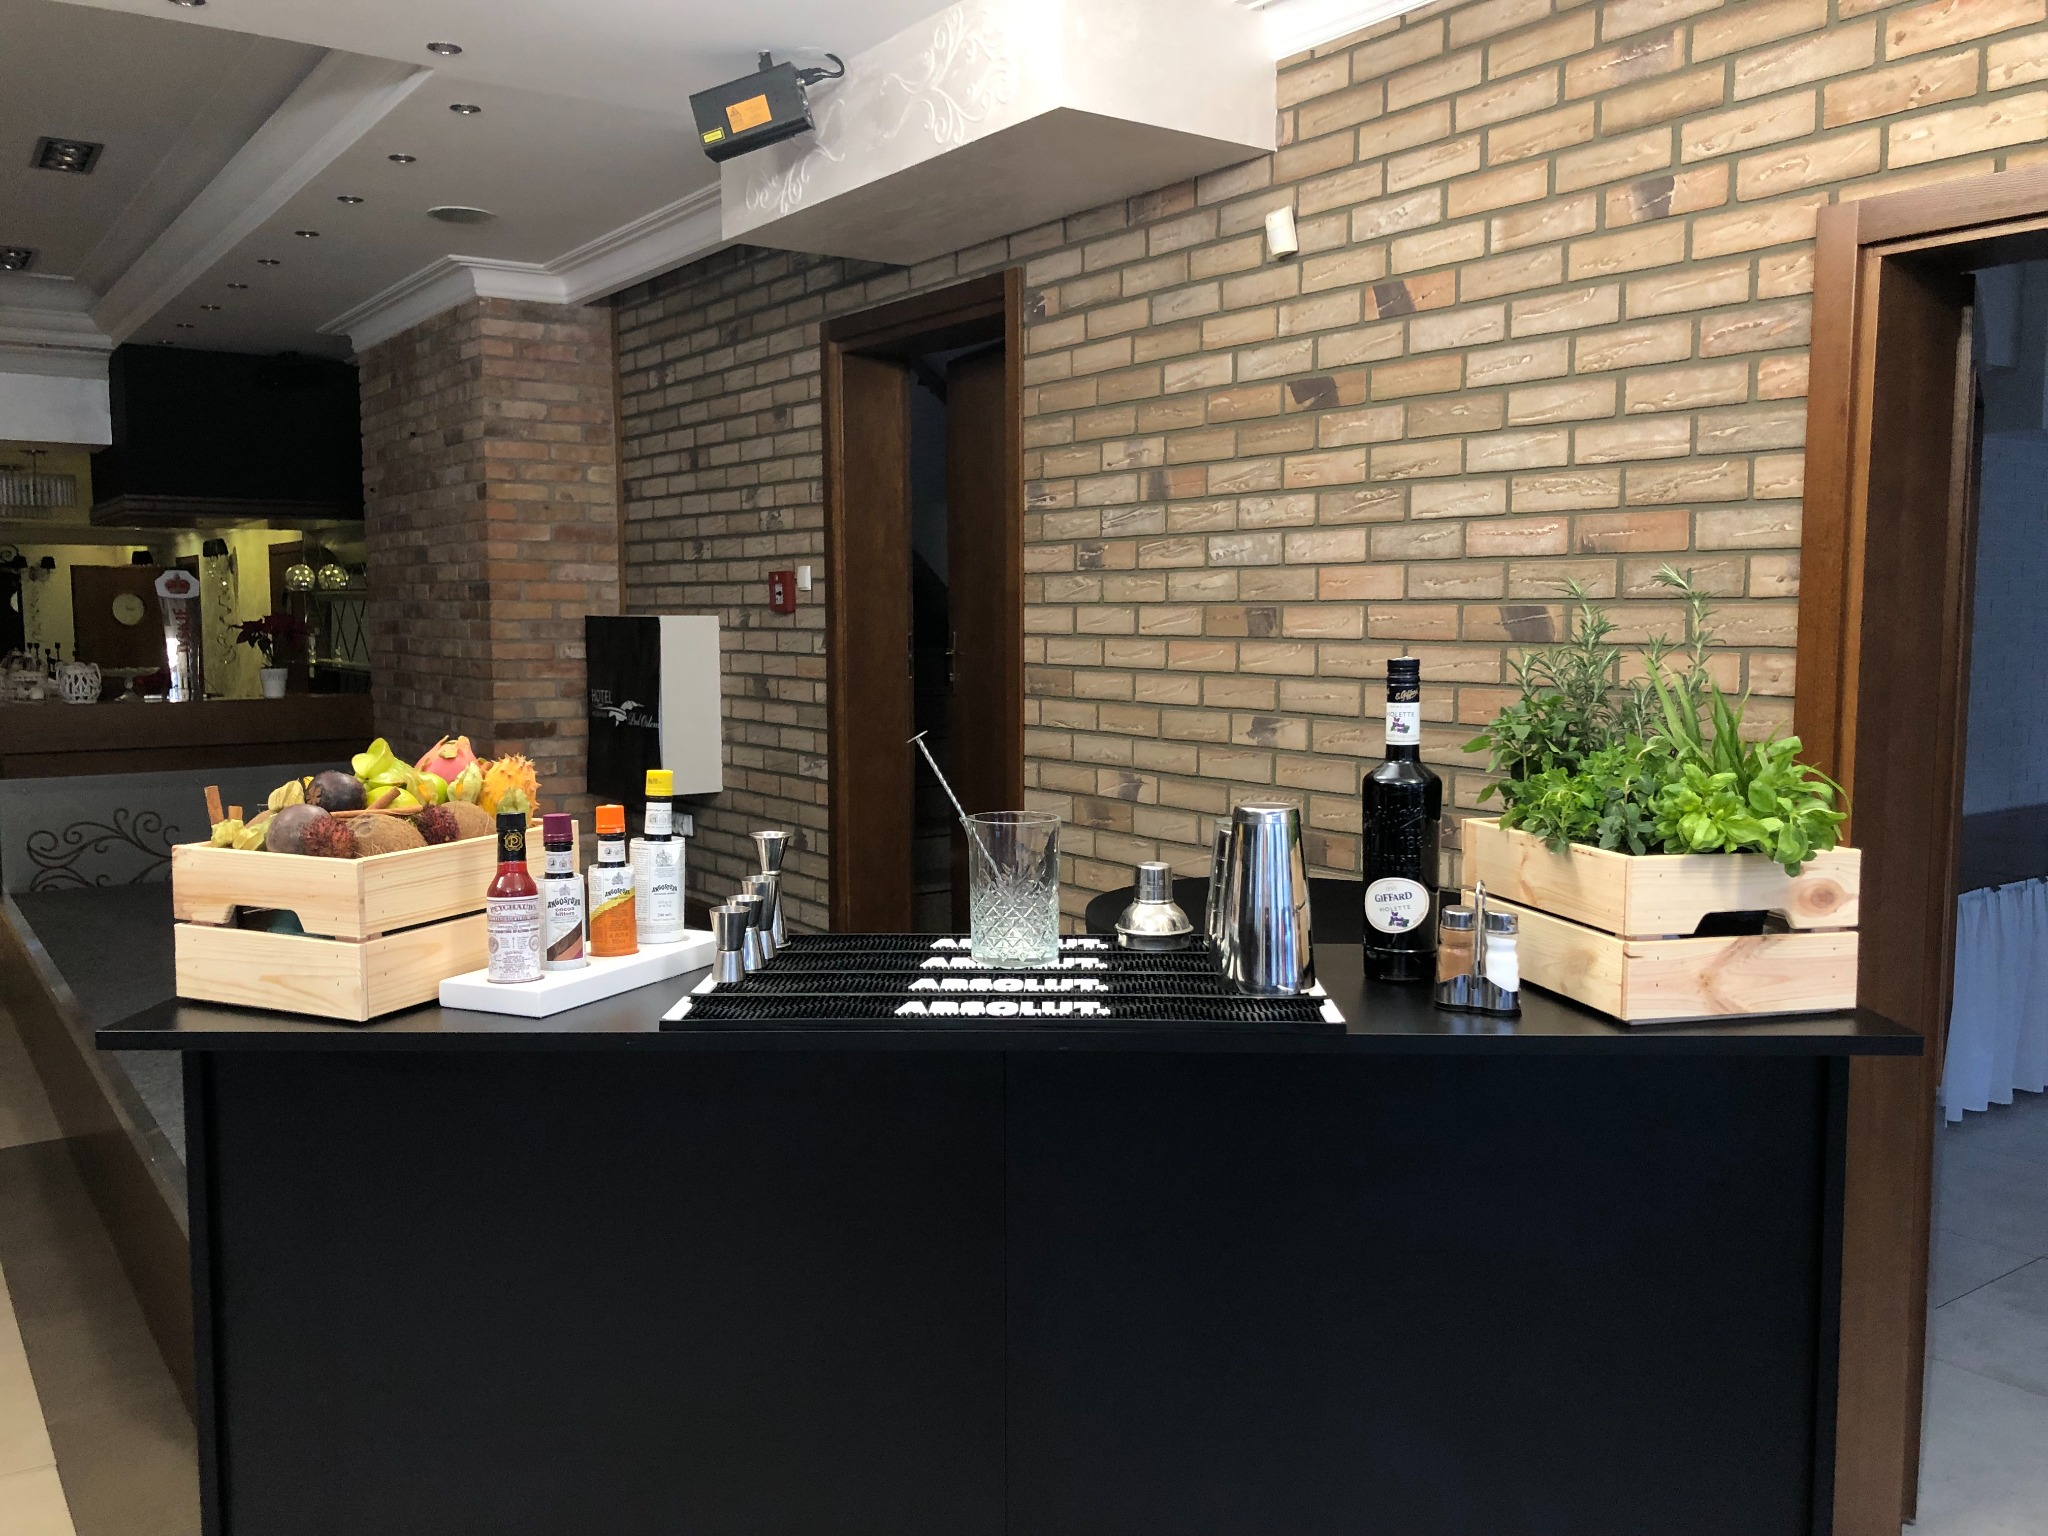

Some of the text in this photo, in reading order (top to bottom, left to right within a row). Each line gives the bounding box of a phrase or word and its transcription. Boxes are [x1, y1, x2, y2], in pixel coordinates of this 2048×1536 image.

[591, 689, 613, 704] HOTEL
[651, 883, 678, 893] ANGOSTURA
[547, 896, 581, 909] ANGOSTURA
[1378, 904, 1411, 912] VIOLETTE
